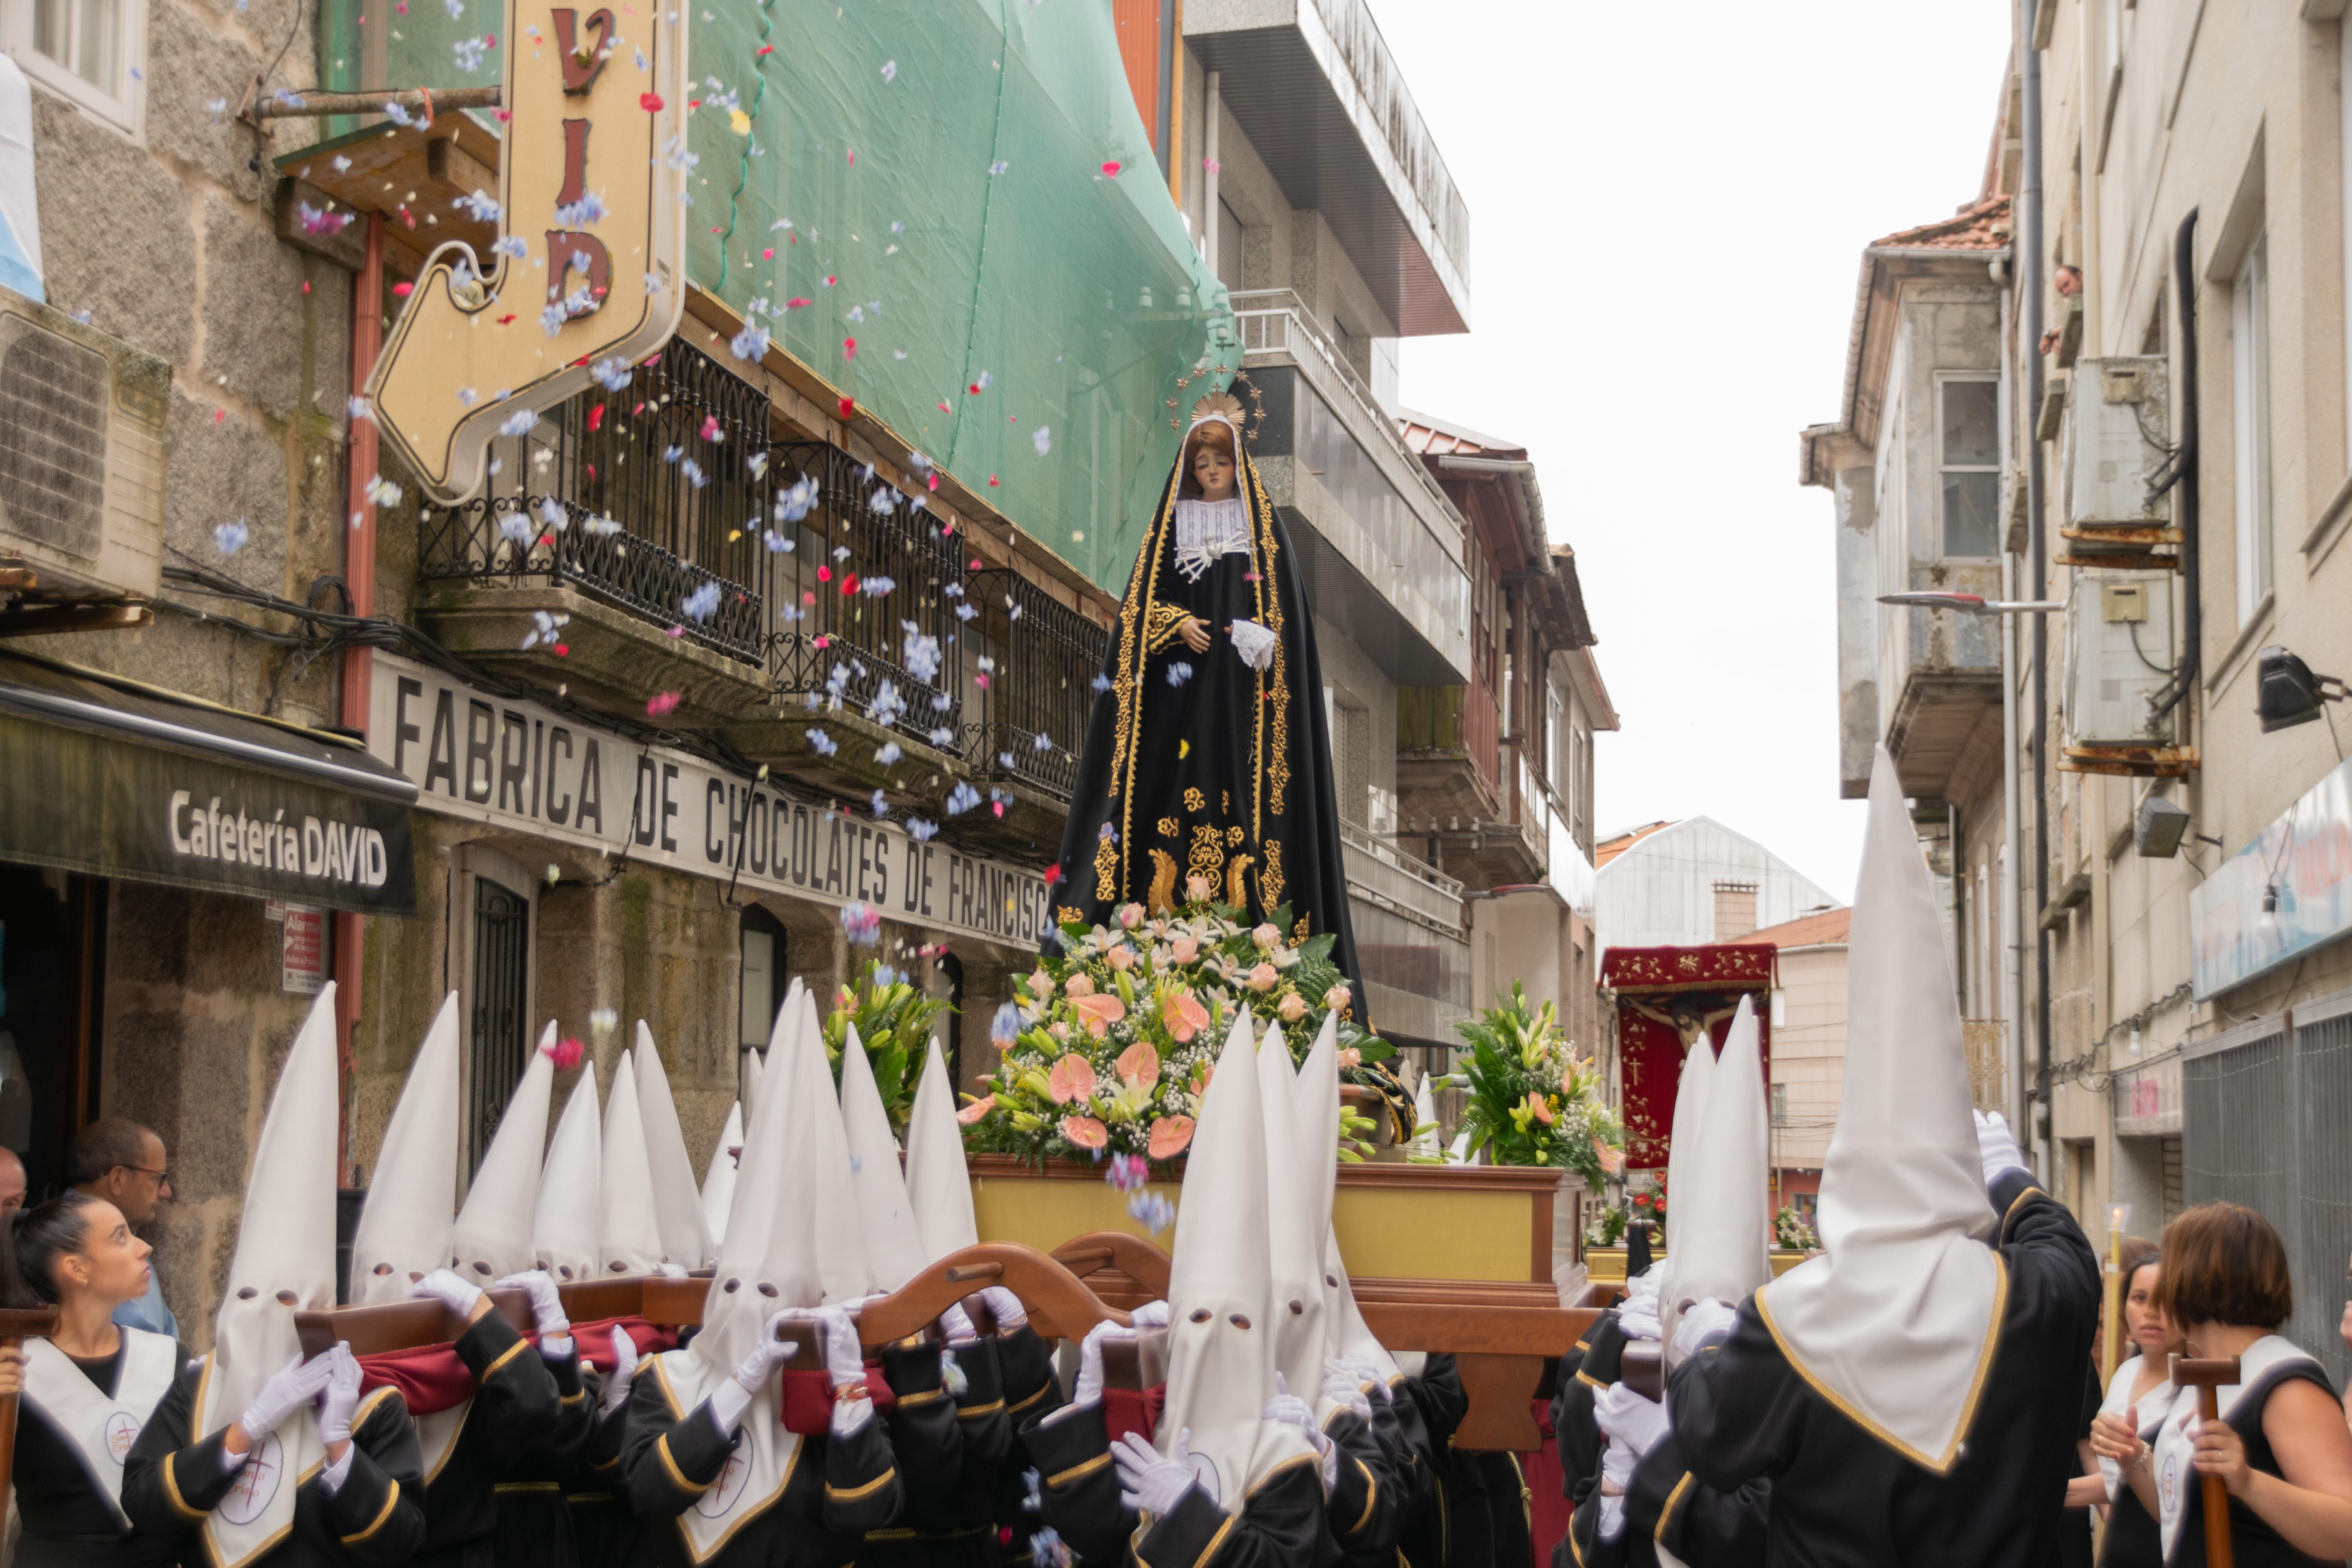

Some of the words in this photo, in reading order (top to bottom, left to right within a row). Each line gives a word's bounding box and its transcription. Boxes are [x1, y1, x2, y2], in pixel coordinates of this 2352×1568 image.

[171, 790, 300, 872] Cafetería
[304, 815, 387, 886] DAVID
[395, 675, 602, 834] FABRICA
[635, 754, 679, 853] DE
[705, 777, 888, 905] CHOCOLATES
[905, 841, 933, 916] DE
[949, 854, 1051, 944] FRANCISC
[286, 914, 321, 934] Alarma
